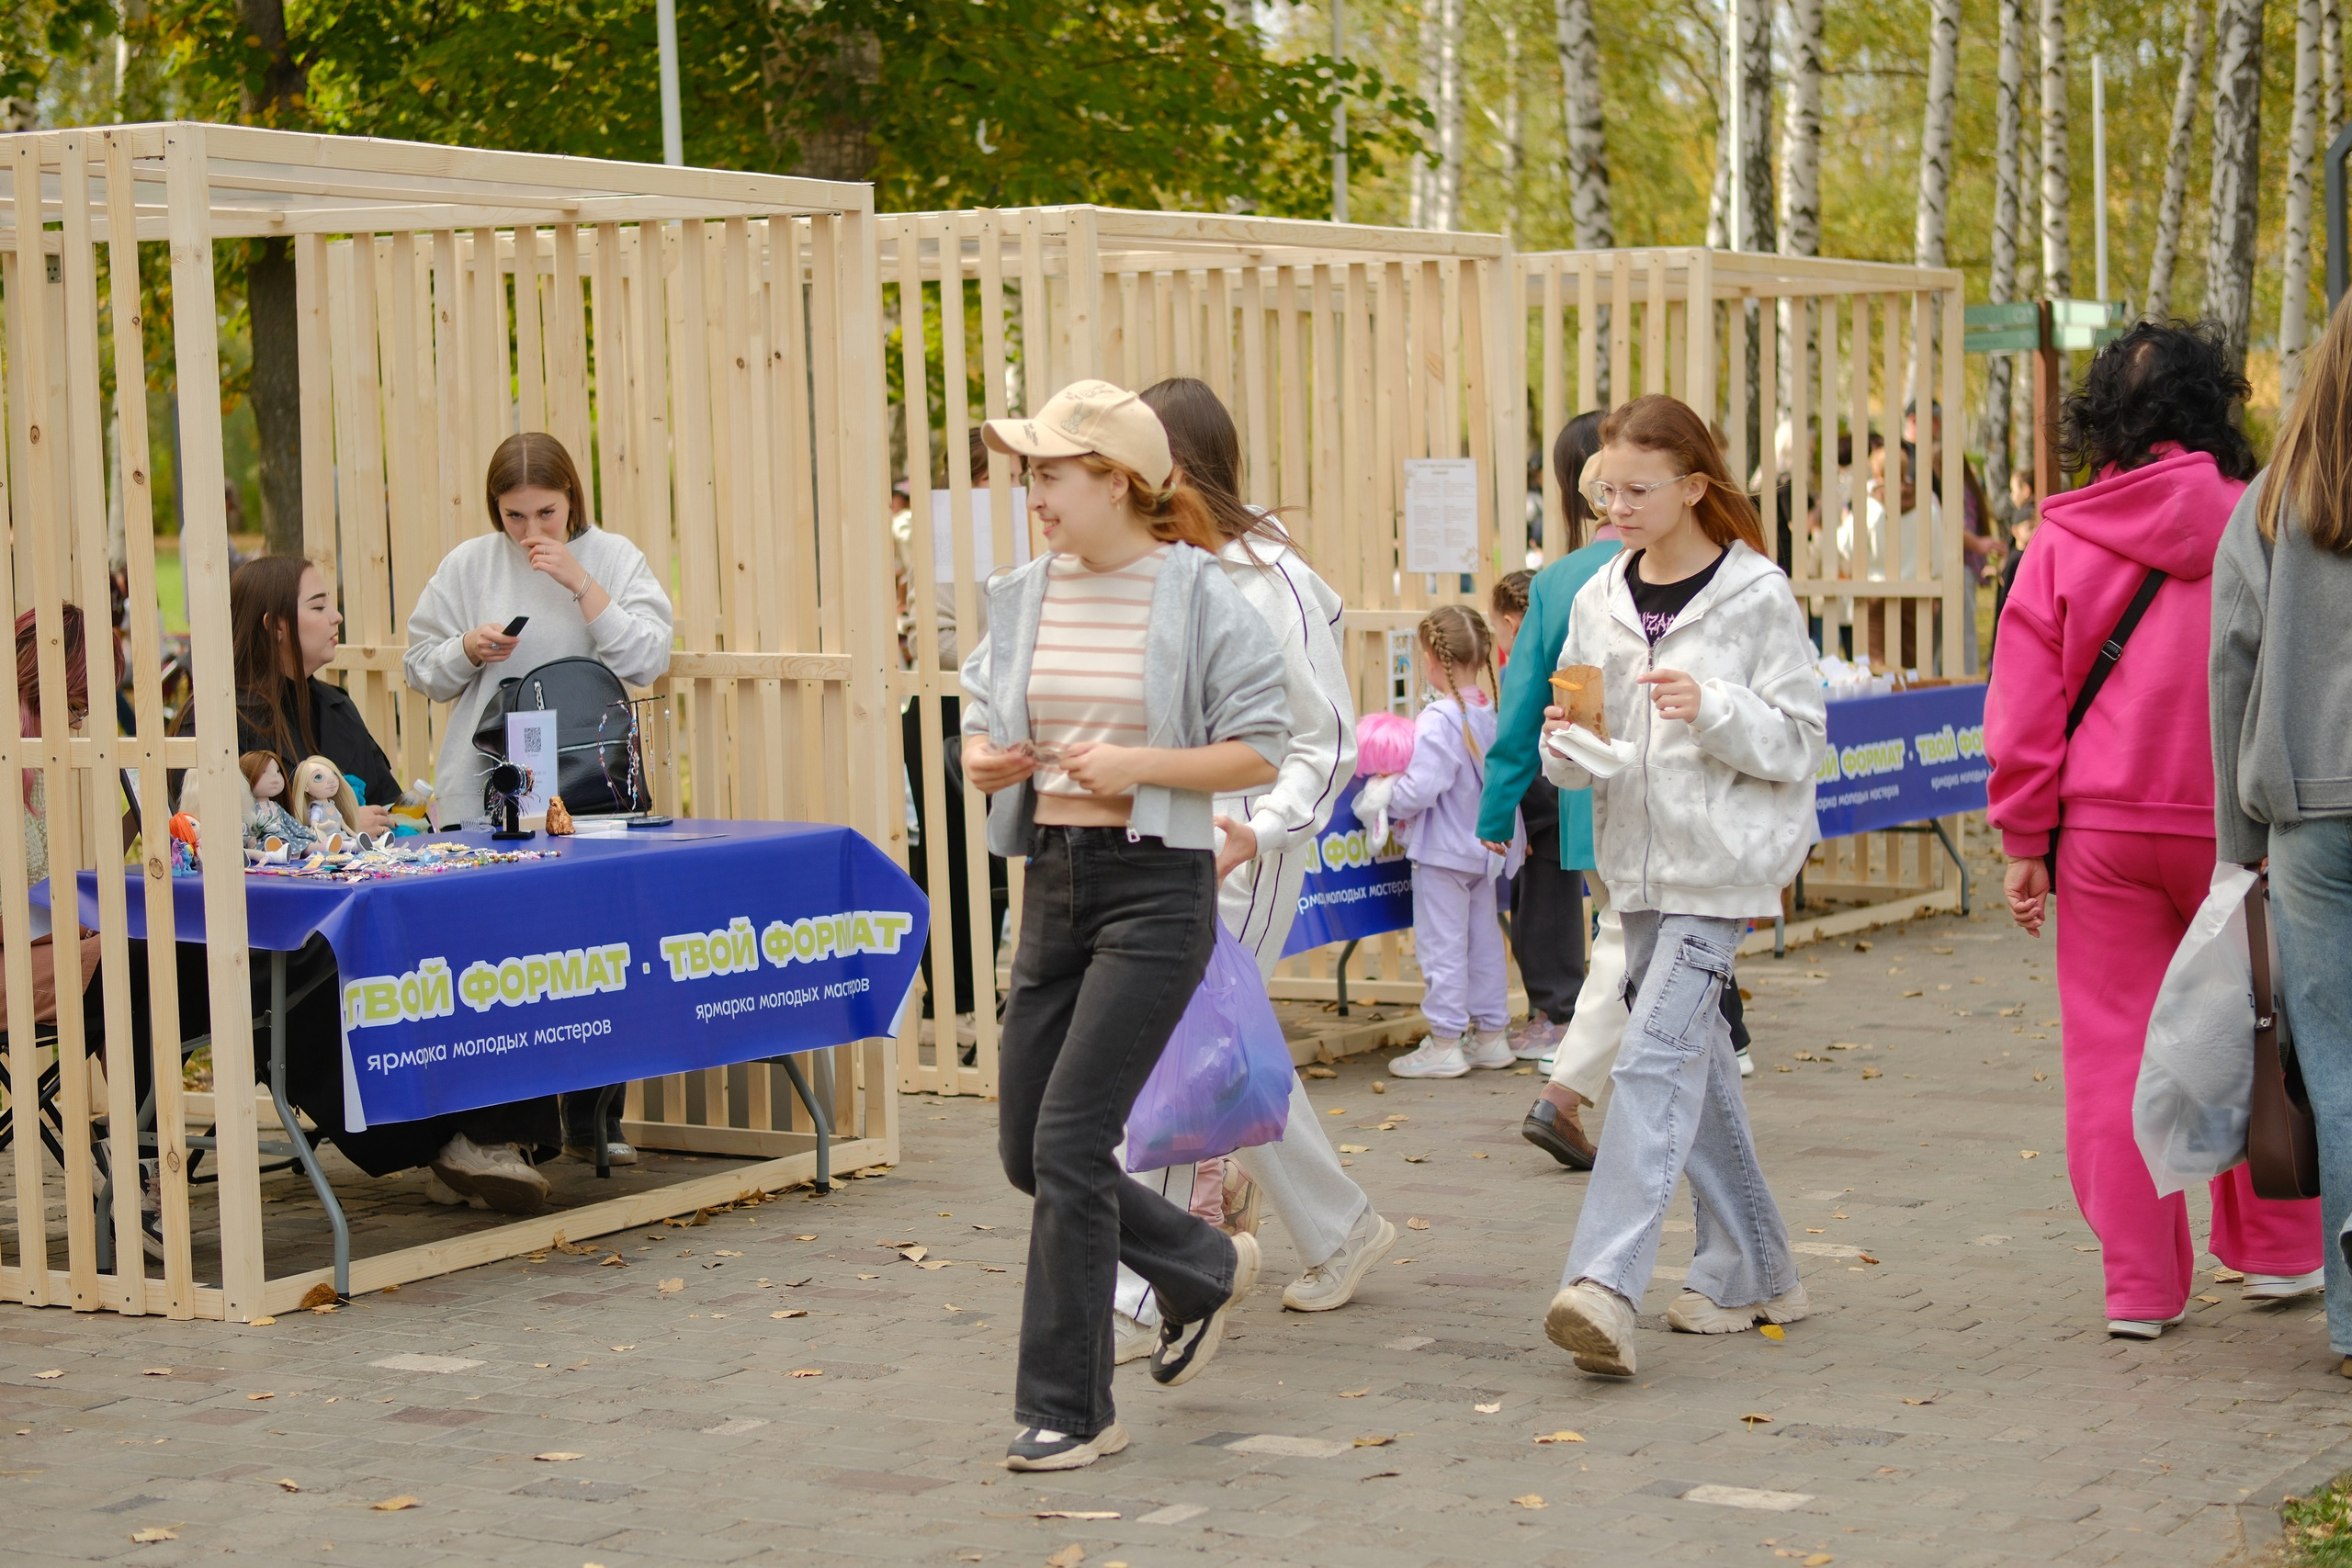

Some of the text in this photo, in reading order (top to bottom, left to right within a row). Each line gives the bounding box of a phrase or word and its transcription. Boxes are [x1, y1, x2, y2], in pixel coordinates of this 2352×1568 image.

[1840, 738, 1905, 781] ФОРМАТ
[1915, 724, 1959, 766] ТВОЙ
[344, 910, 913, 1031] ТВОЙ ФОРМАТ ТВОЙ ФОРМАТ
[695, 978, 870, 1024] ярмарка молодых мастеров
[368, 1019, 612, 1076] ярмарка молодых мастеров
